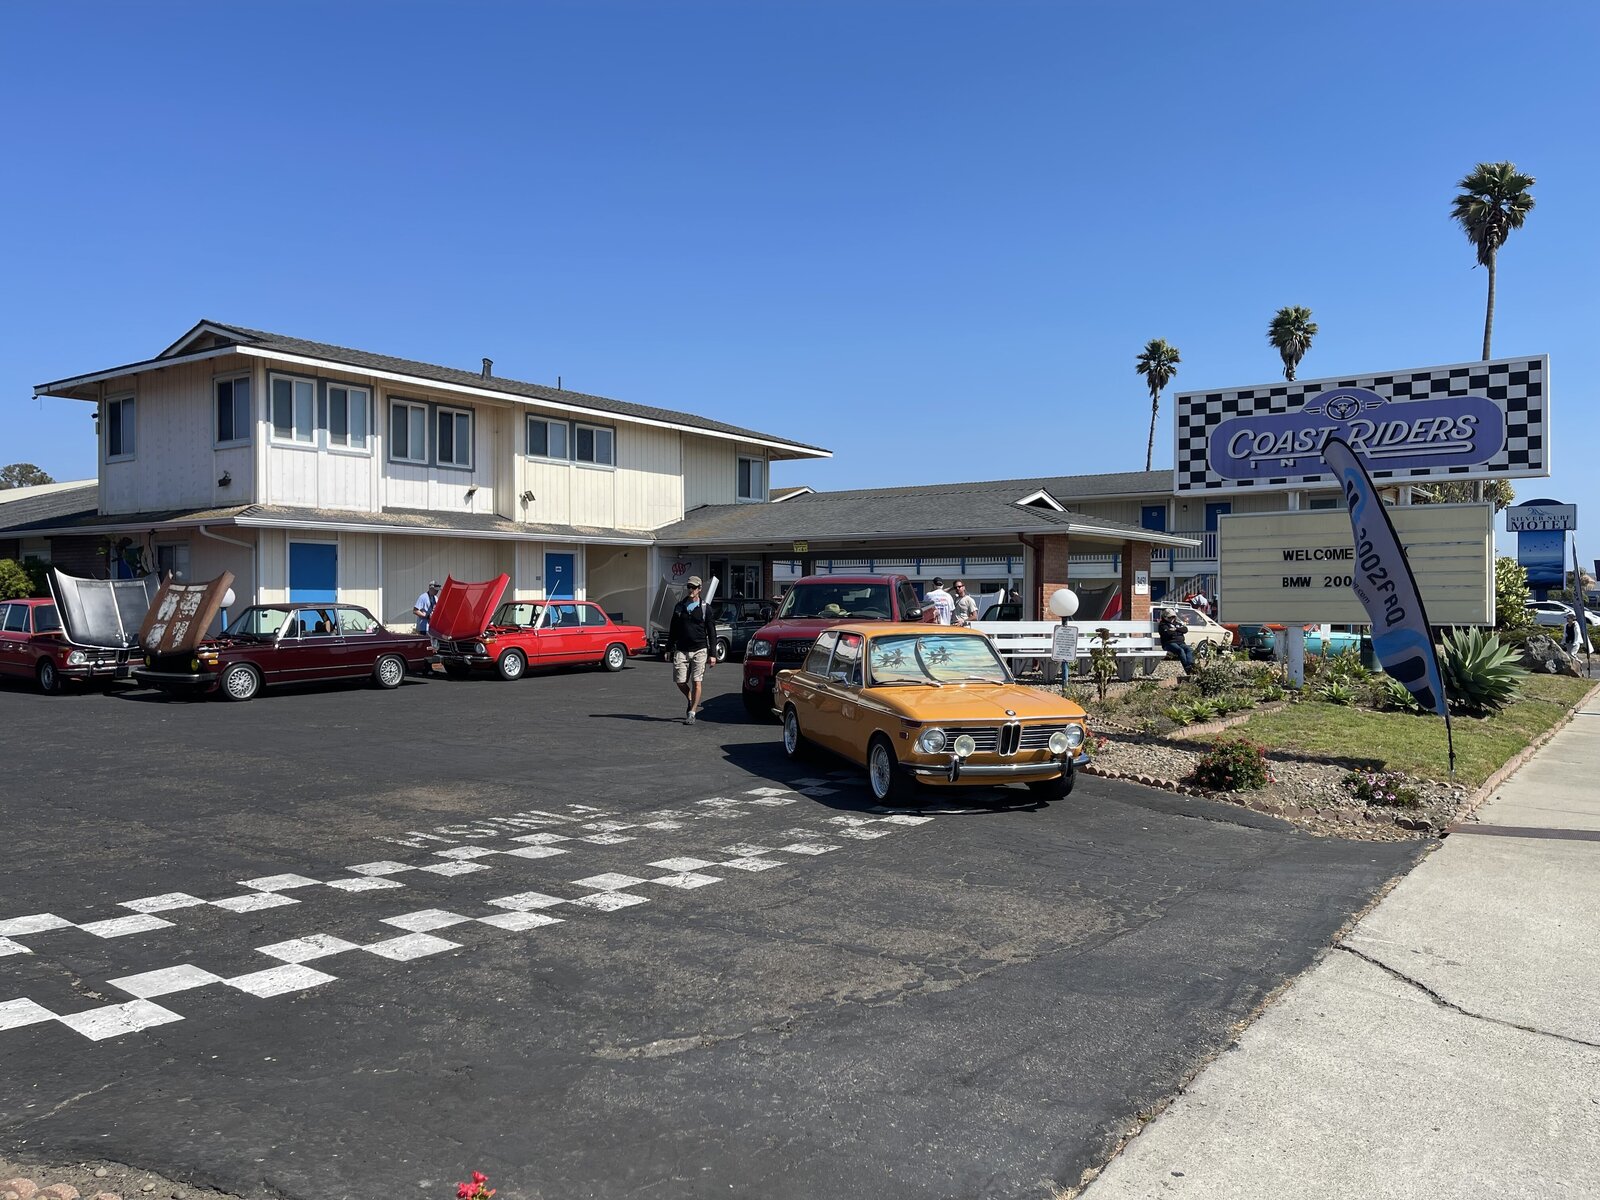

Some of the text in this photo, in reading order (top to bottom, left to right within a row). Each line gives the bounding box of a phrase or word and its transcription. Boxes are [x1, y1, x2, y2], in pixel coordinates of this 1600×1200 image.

[1227, 415, 1477, 459] COAST RIDERS
[1511, 520, 1571, 530] MOTEL
[1282, 548, 1354, 561] WELCOME
[1282, 576, 1312, 588] BMW
